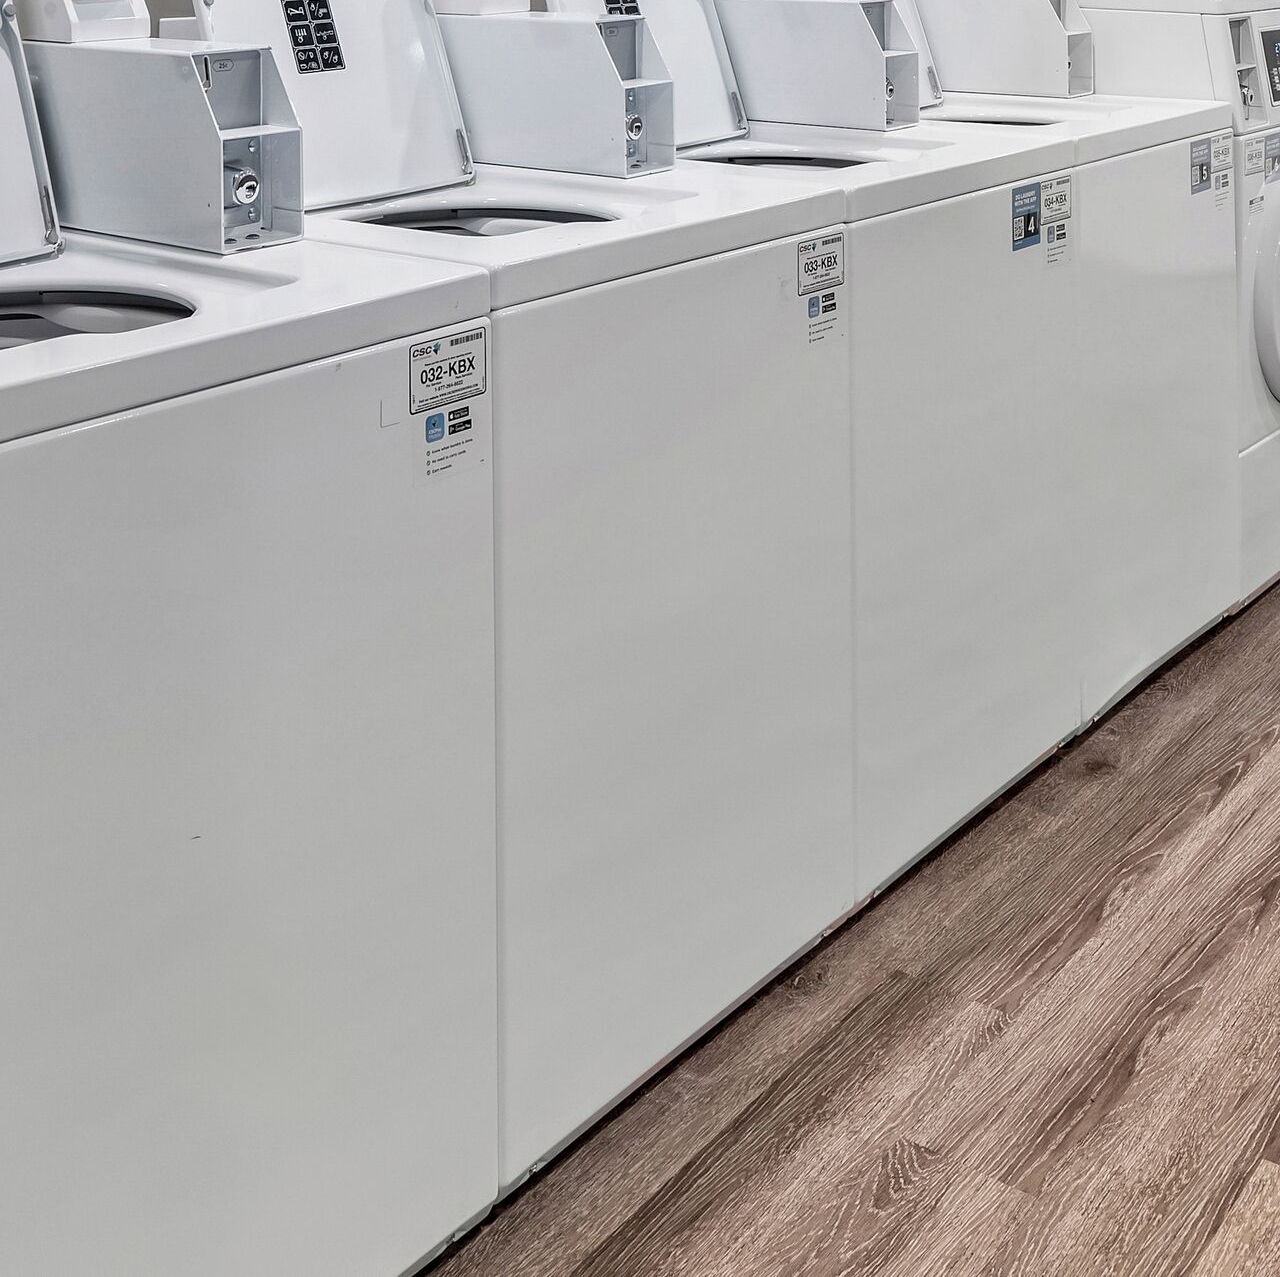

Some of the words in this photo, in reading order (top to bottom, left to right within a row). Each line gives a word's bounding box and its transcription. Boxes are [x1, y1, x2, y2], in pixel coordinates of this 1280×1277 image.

[1202, 166, 1208, 181] 5
[1044, 193, 1068, 208] 034-KBX
[1028, 216, 1035, 233] 4
[800, 244, 812, 253] CSC
[804, 254, 838, 274] 033-KBX
[412, 345, 432, 359] CSC
[420, 355, 476, 385] 032-KBX
